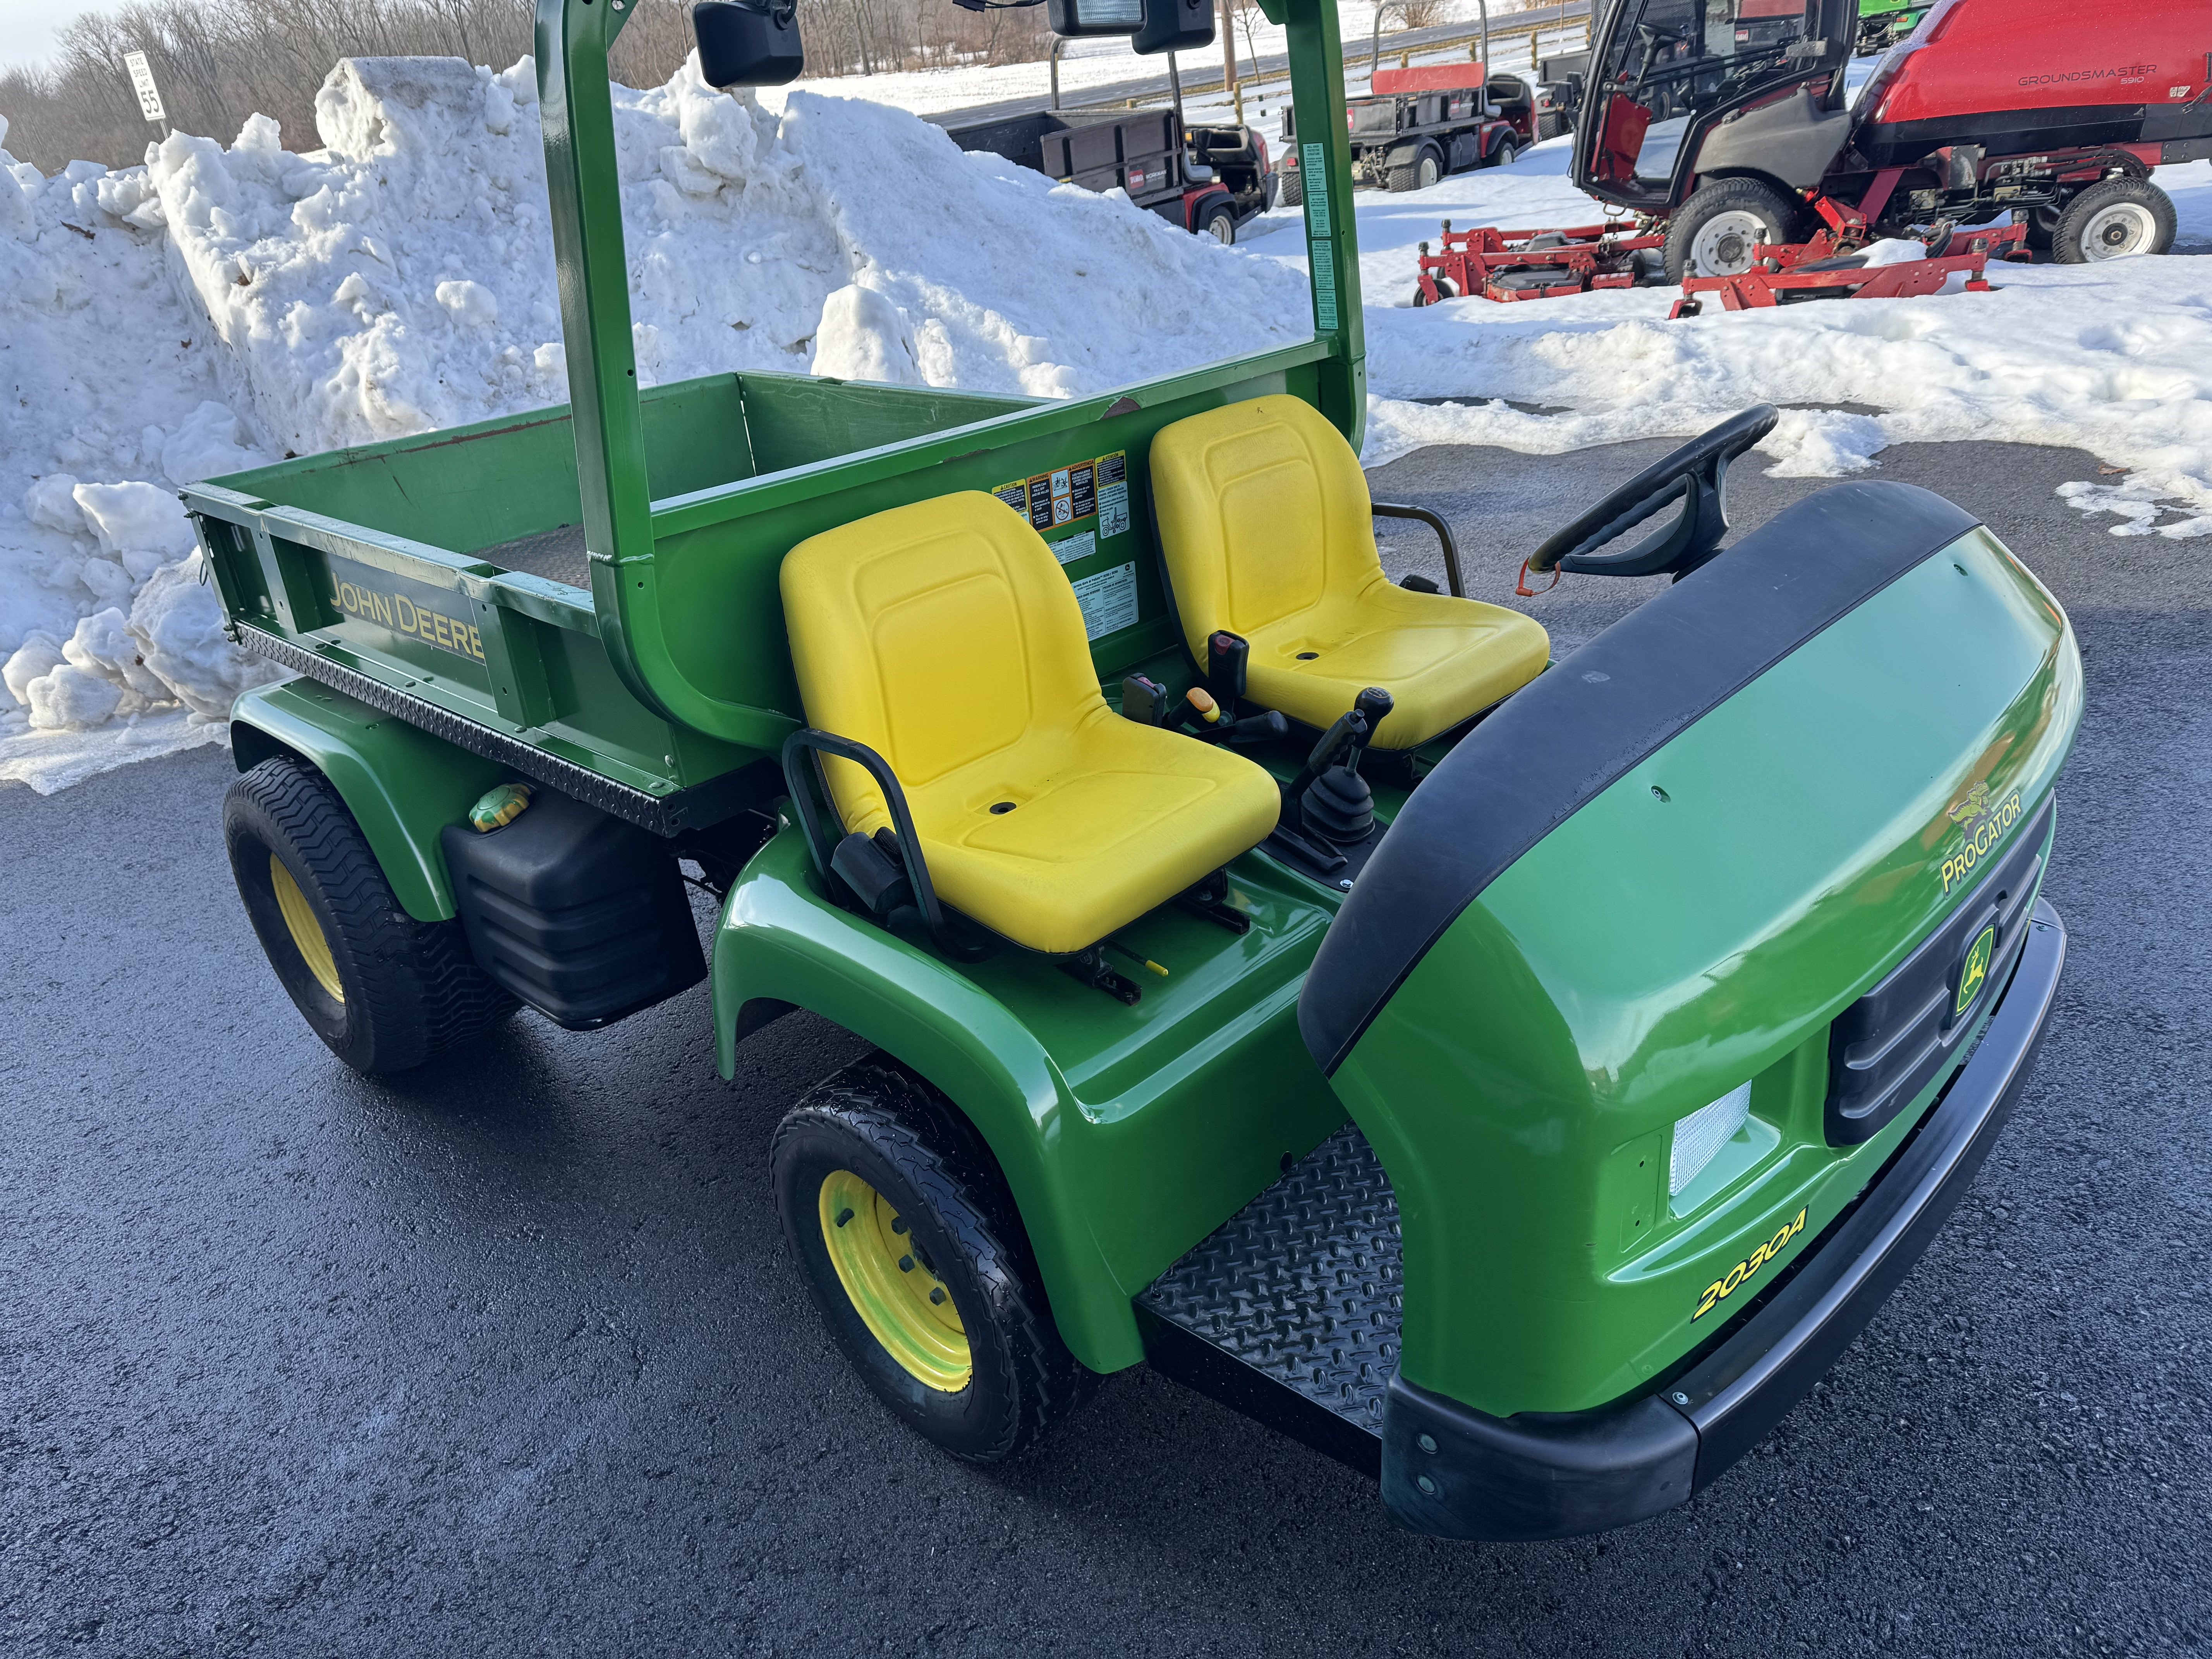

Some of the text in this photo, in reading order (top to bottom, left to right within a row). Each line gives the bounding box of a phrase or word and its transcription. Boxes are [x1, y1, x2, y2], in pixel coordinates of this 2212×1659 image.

[130, 57, 144, 67] STATE
[133, 68, 147, 77] SPEED
[2018, 64, 2157, 86] GROUNDSMASTER
[138, 79, 150, 88] LIMIT
[2121, 76, 2144, 84] 5910
[141, 90, 159, 114] 55
[1130, 174, 1143, 184] TORO
[1146, 169, 1167, 179] WORKMAN
[1072, 460, 1094, 470] ADVERTENCIA
[1032, 473, 1049, 481] WARNING
[330, 573, 484, 659] JOHN DEERE
[1940, 793, 2022, 893] PROGATOR
[1692, 1206, 1808, 1321] 2030A
